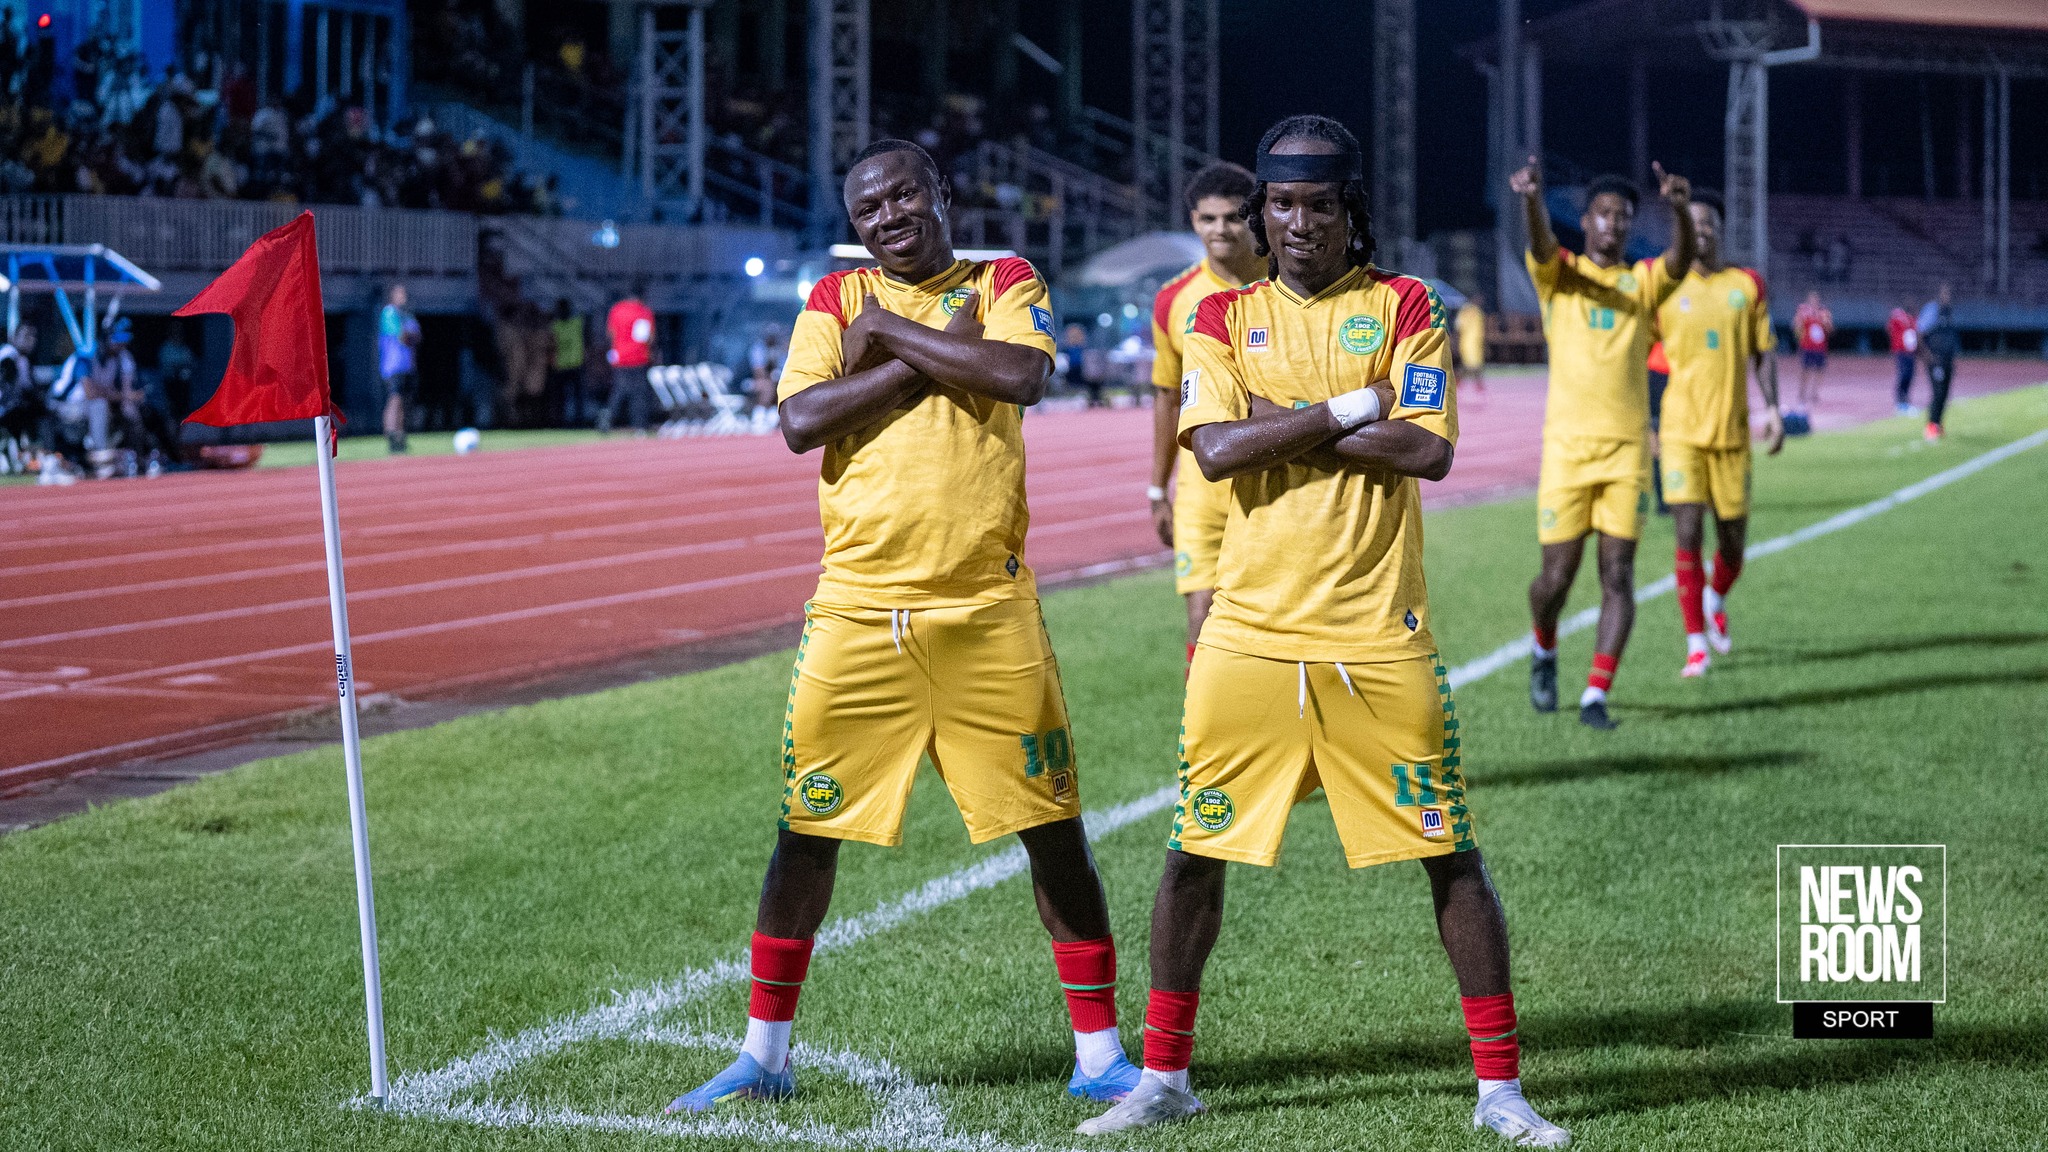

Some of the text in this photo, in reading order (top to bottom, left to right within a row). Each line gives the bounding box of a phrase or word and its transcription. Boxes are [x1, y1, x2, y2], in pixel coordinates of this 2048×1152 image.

[949, 298, 967, 307] GF
[1348, 328, 1376, 340] GFF
[1413, 371, 1438, 380] FOOTBALL
[1412, 377, 1438, 388] UNITES
[335, 654, 348, 698] capelli
[1020, 726, 1070, 778] 10
[1391, 764, 1438, 807] 11
[808, 787, 835, 800] GFF
[1200, 803, 1227, 816] GFF
